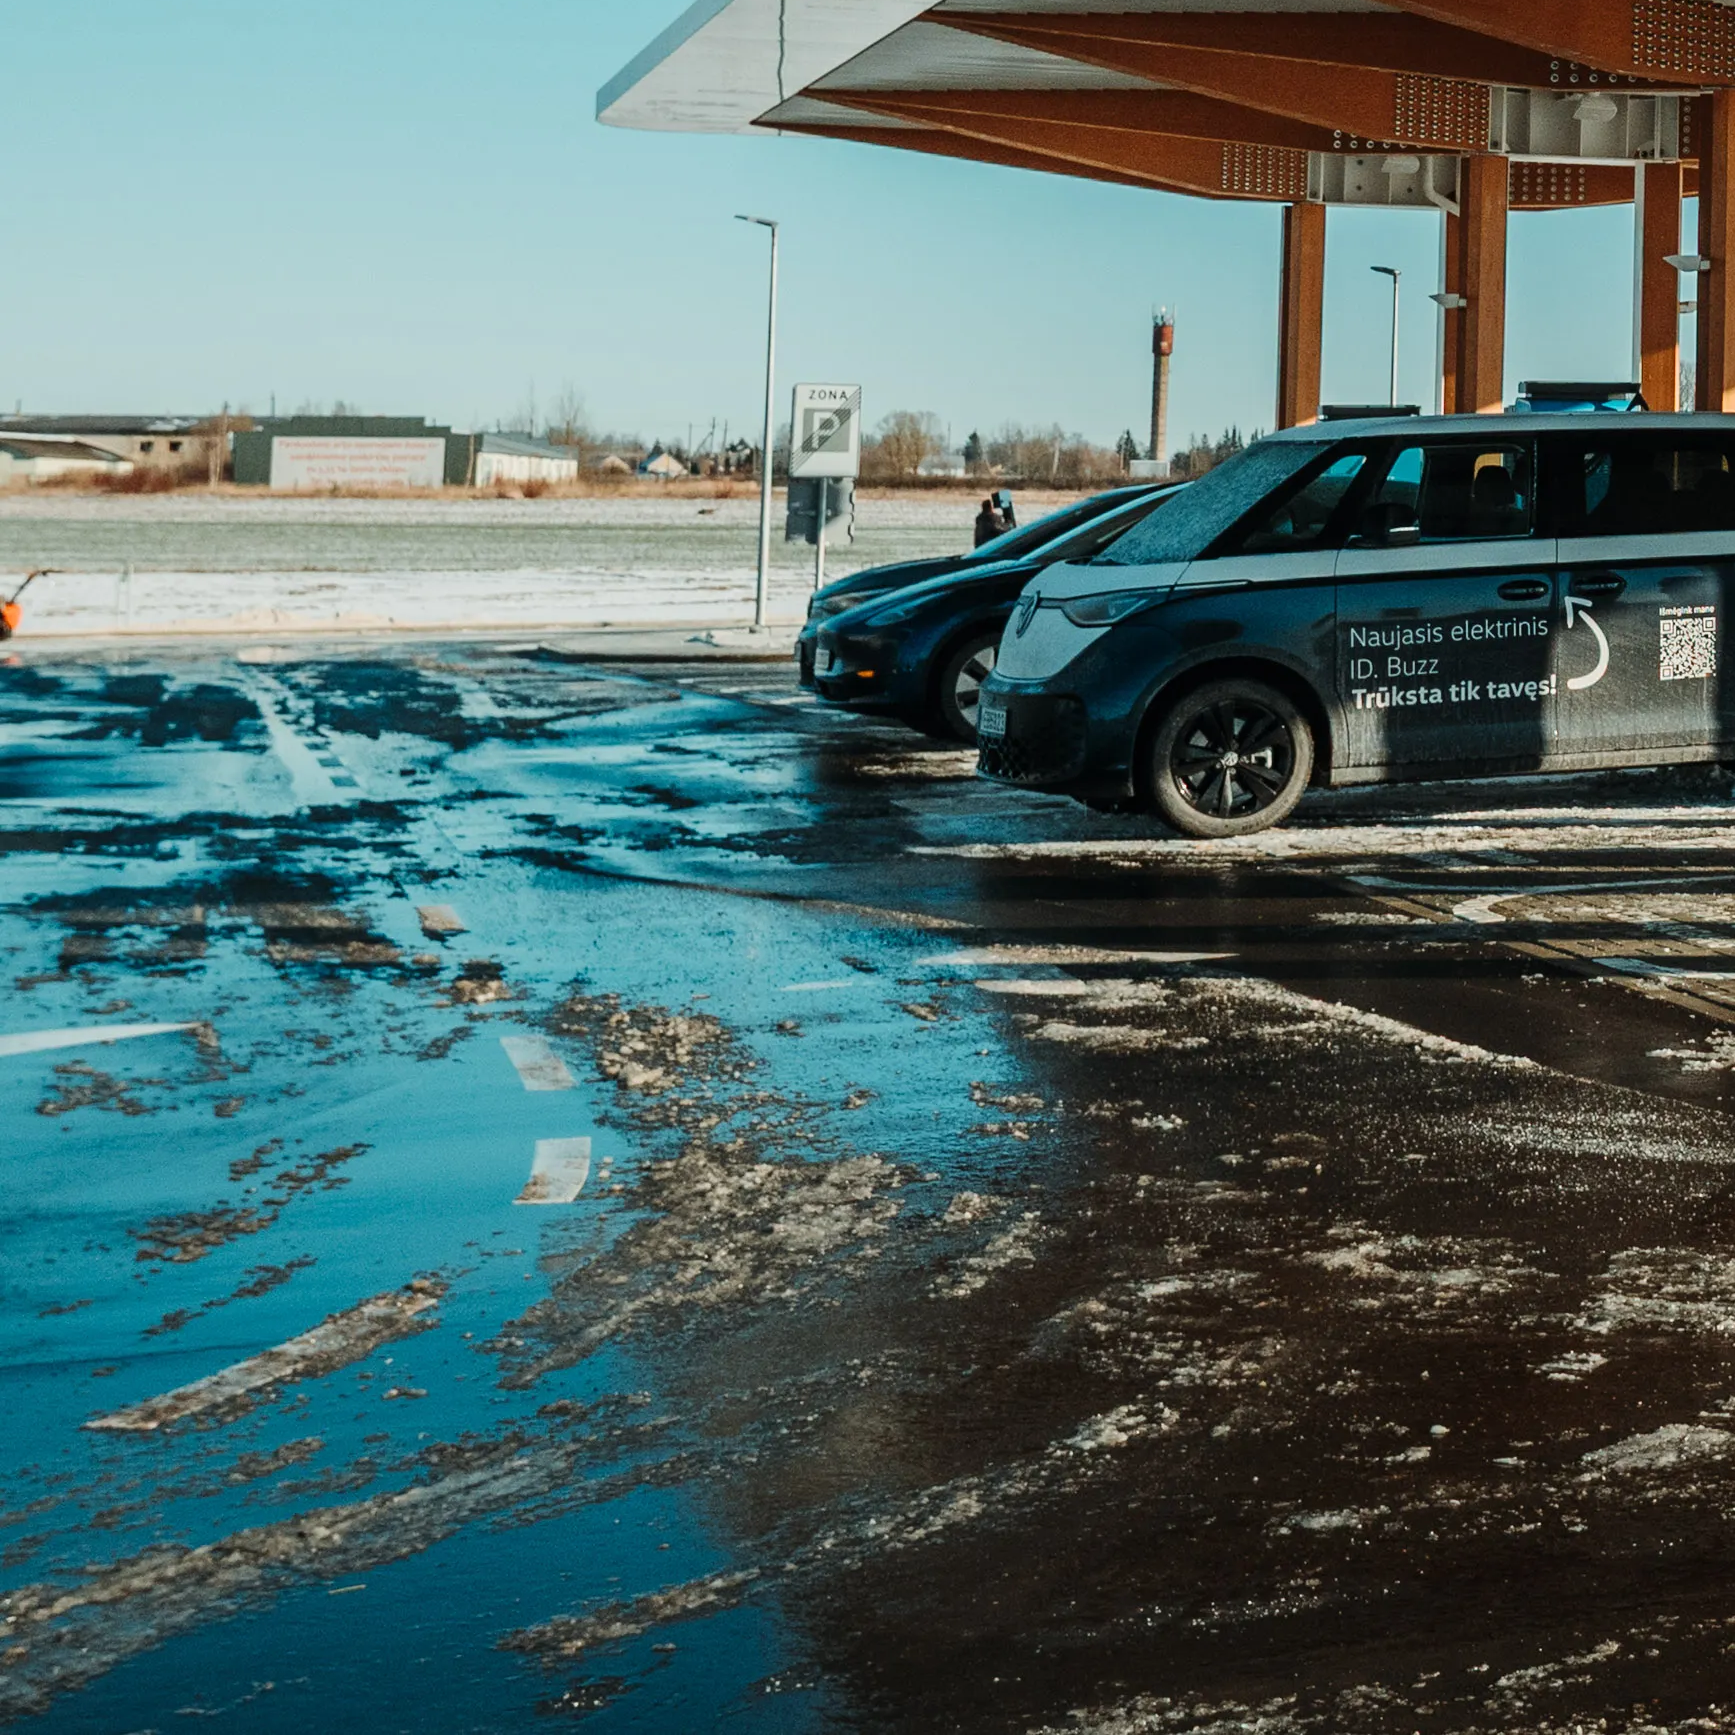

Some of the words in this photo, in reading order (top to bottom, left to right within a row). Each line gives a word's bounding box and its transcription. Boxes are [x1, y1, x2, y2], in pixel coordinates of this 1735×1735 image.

[808, 389, 848, 401] ZONA
[1350, 624, 1443, 651] Naujasis
[1450, 616, 1548, 642] elektrinis
[1350, 658, 1378, 679] ID.
[1387, 656, 1439, 677] Buzz
[1351, 685, 1443, 709] Trūksta
[1448, 680, 1480, 702] tik
[1486, 673, 1557, 701] tavęs!
